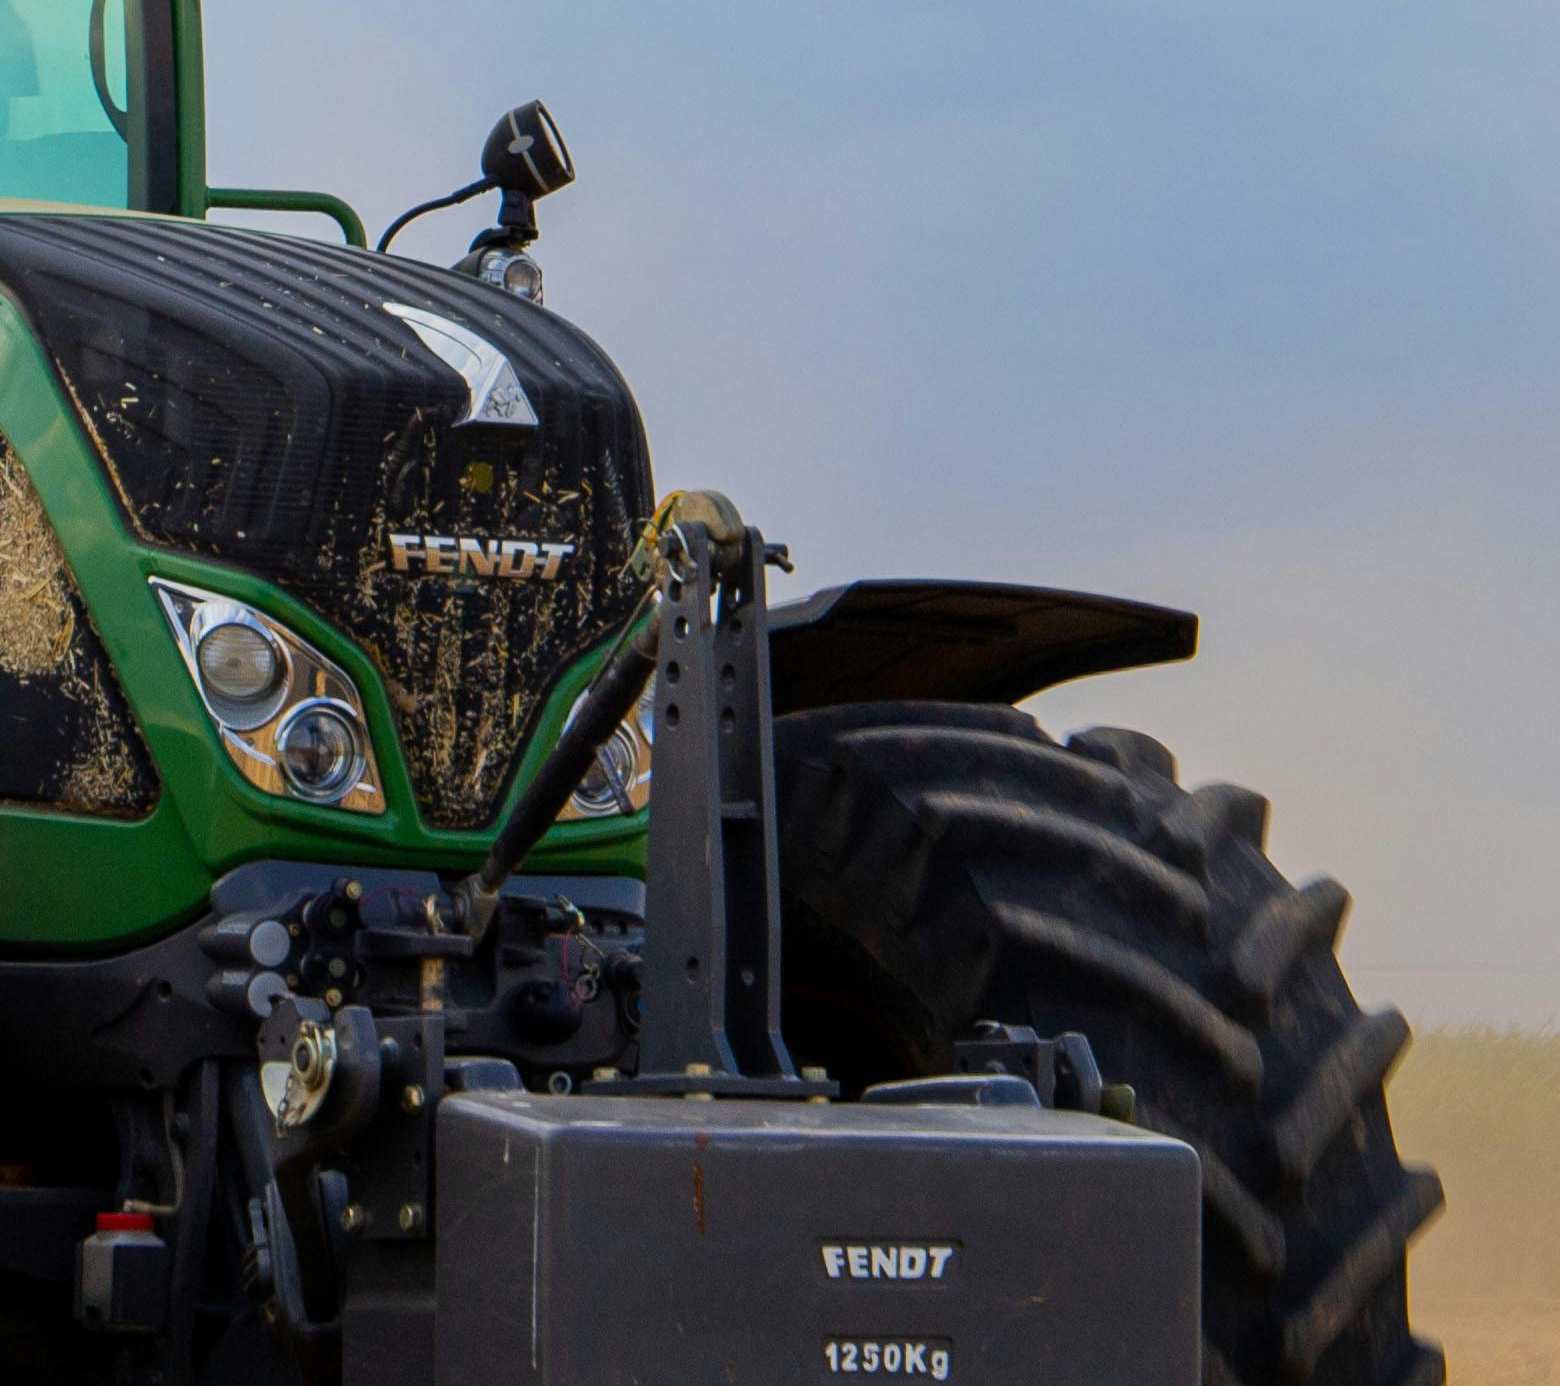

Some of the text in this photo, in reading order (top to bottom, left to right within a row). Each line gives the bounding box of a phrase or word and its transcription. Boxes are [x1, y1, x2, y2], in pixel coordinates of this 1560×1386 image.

[389, 533, 575, 579] FENDT
[821, 1245, 953, 1278] FENDT
[825, 1342, 949, 1381] 1250Kg
